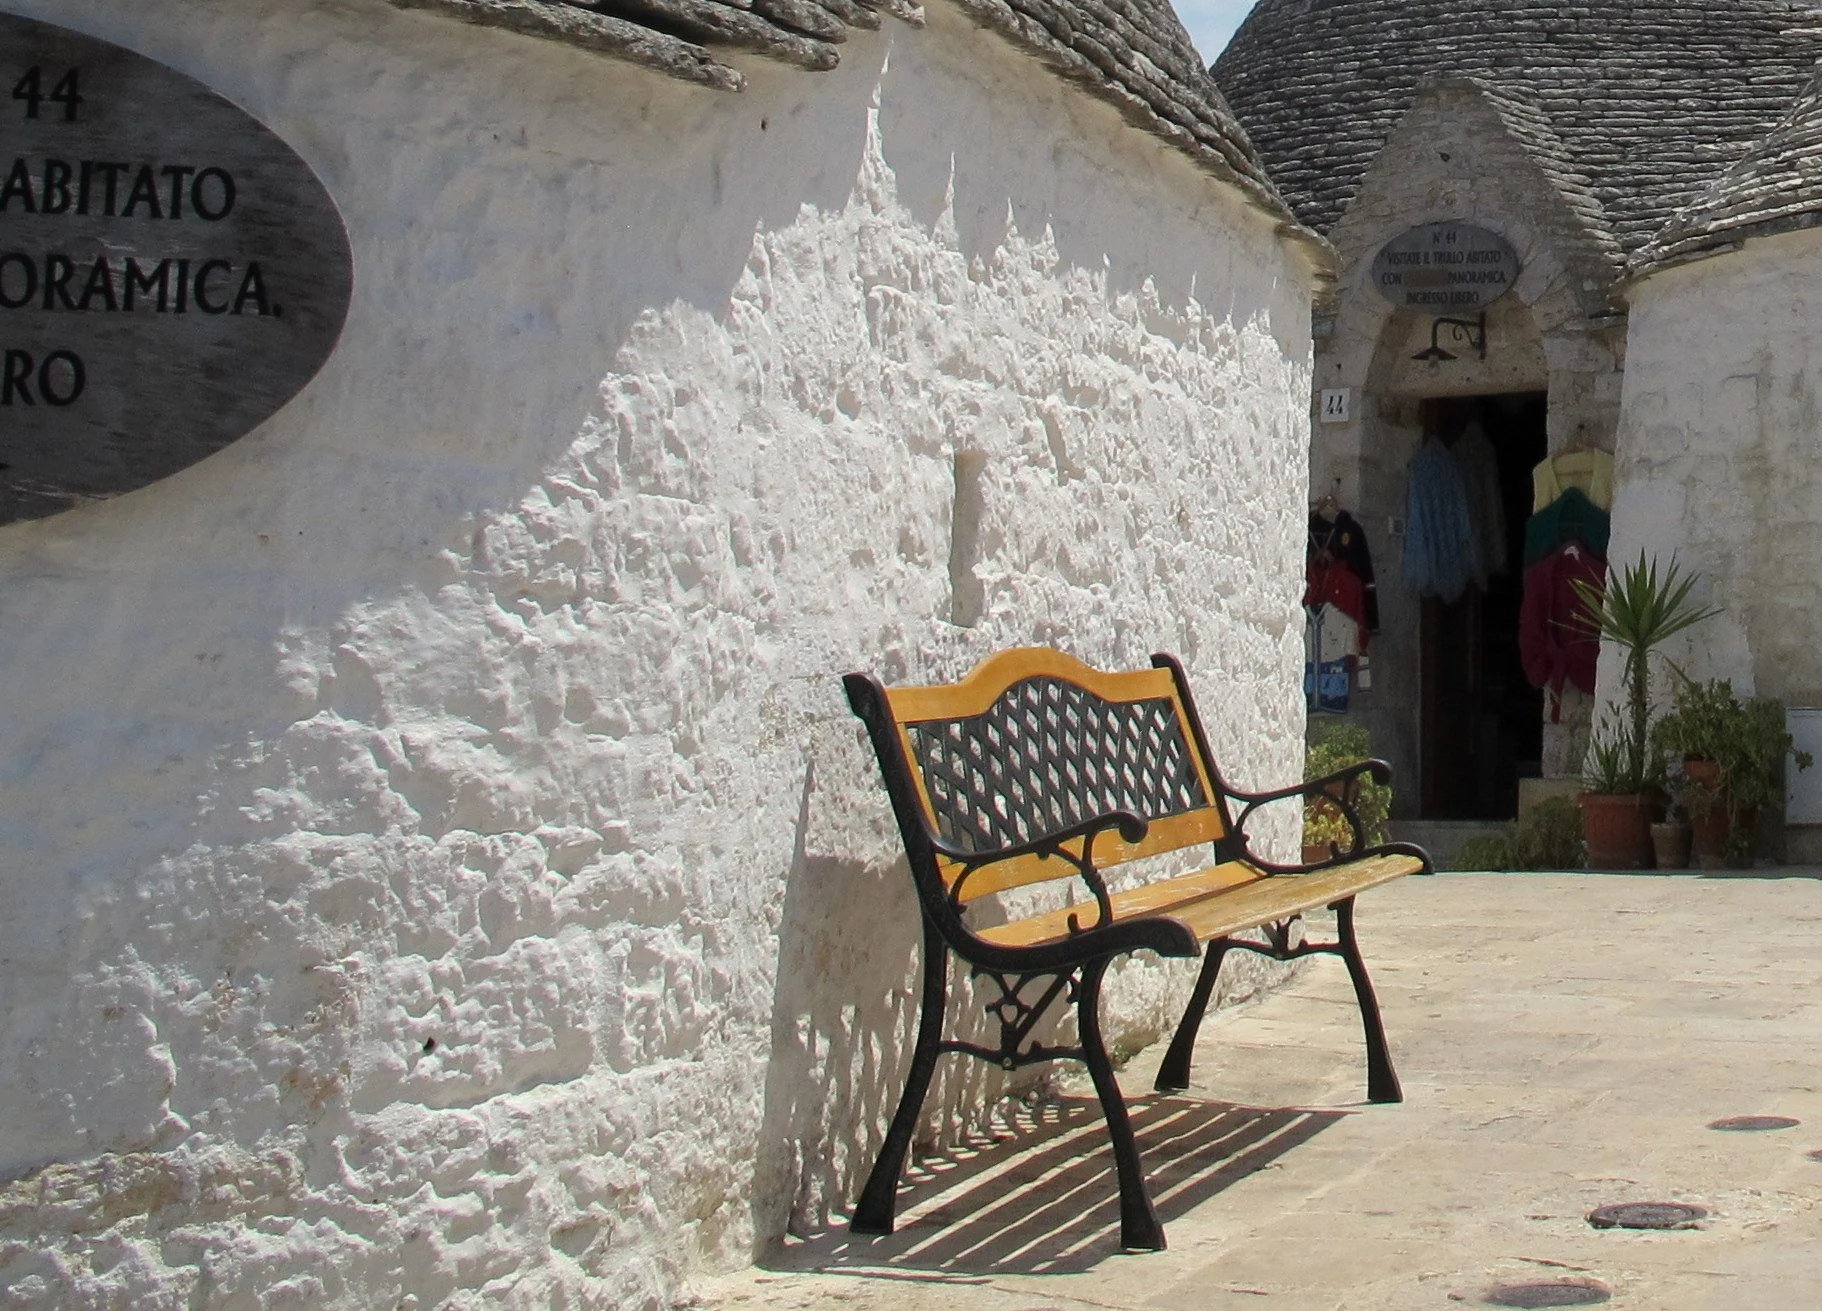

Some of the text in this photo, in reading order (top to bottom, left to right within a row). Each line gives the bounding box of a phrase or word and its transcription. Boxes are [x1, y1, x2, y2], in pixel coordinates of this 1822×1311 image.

[12, 65, 83, 122] 44
[0, 158, 236, 221] ABITATO
[1381, 272, 1402, 285] CON
[0, 348, 86, 407] RO
[1326, 395, 1343, 415] 44
